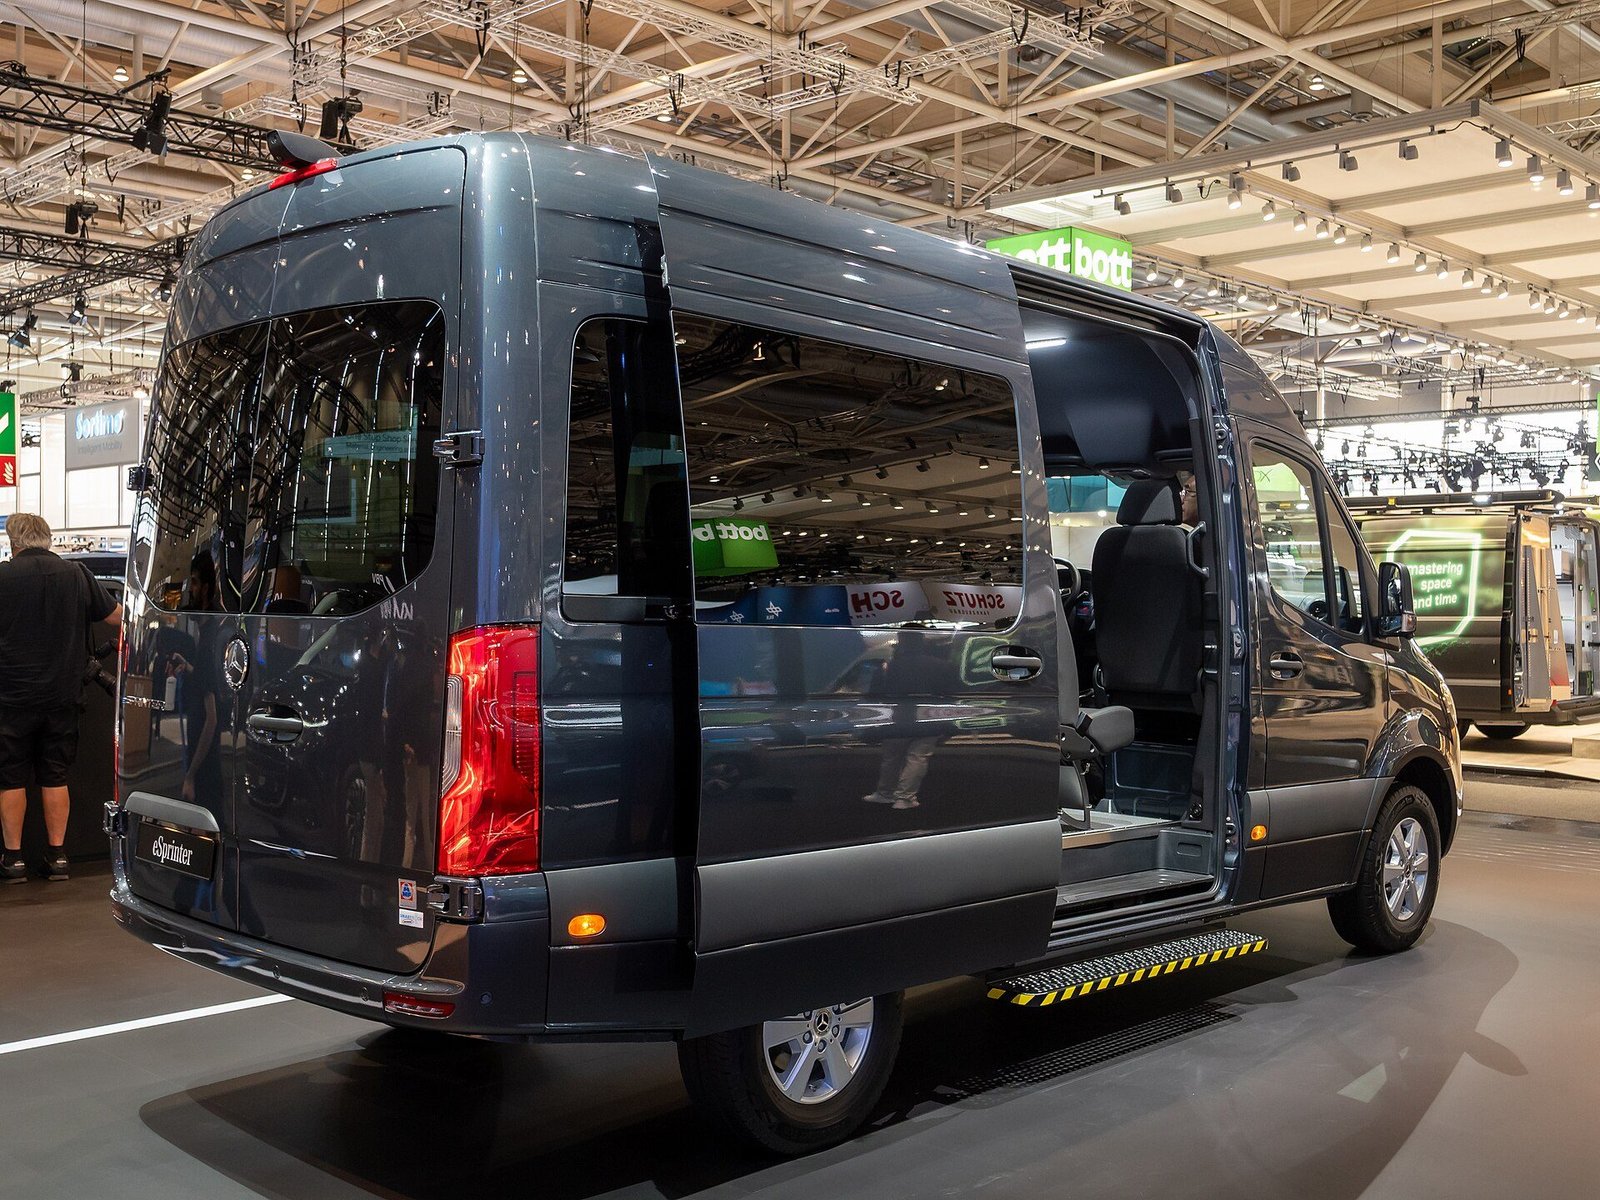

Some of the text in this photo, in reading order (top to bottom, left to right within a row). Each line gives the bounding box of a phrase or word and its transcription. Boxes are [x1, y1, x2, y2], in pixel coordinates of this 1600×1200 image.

[1075, 237, 1132, 288] bott
[75, 408, 124, 440] Sortimo
[1407, 561, 1463, 576] mastering
[1421, 578, 1453, 593] space
[1413, 593, 1458, 609] and time
[152, 835, 193, 867] eSprinter
